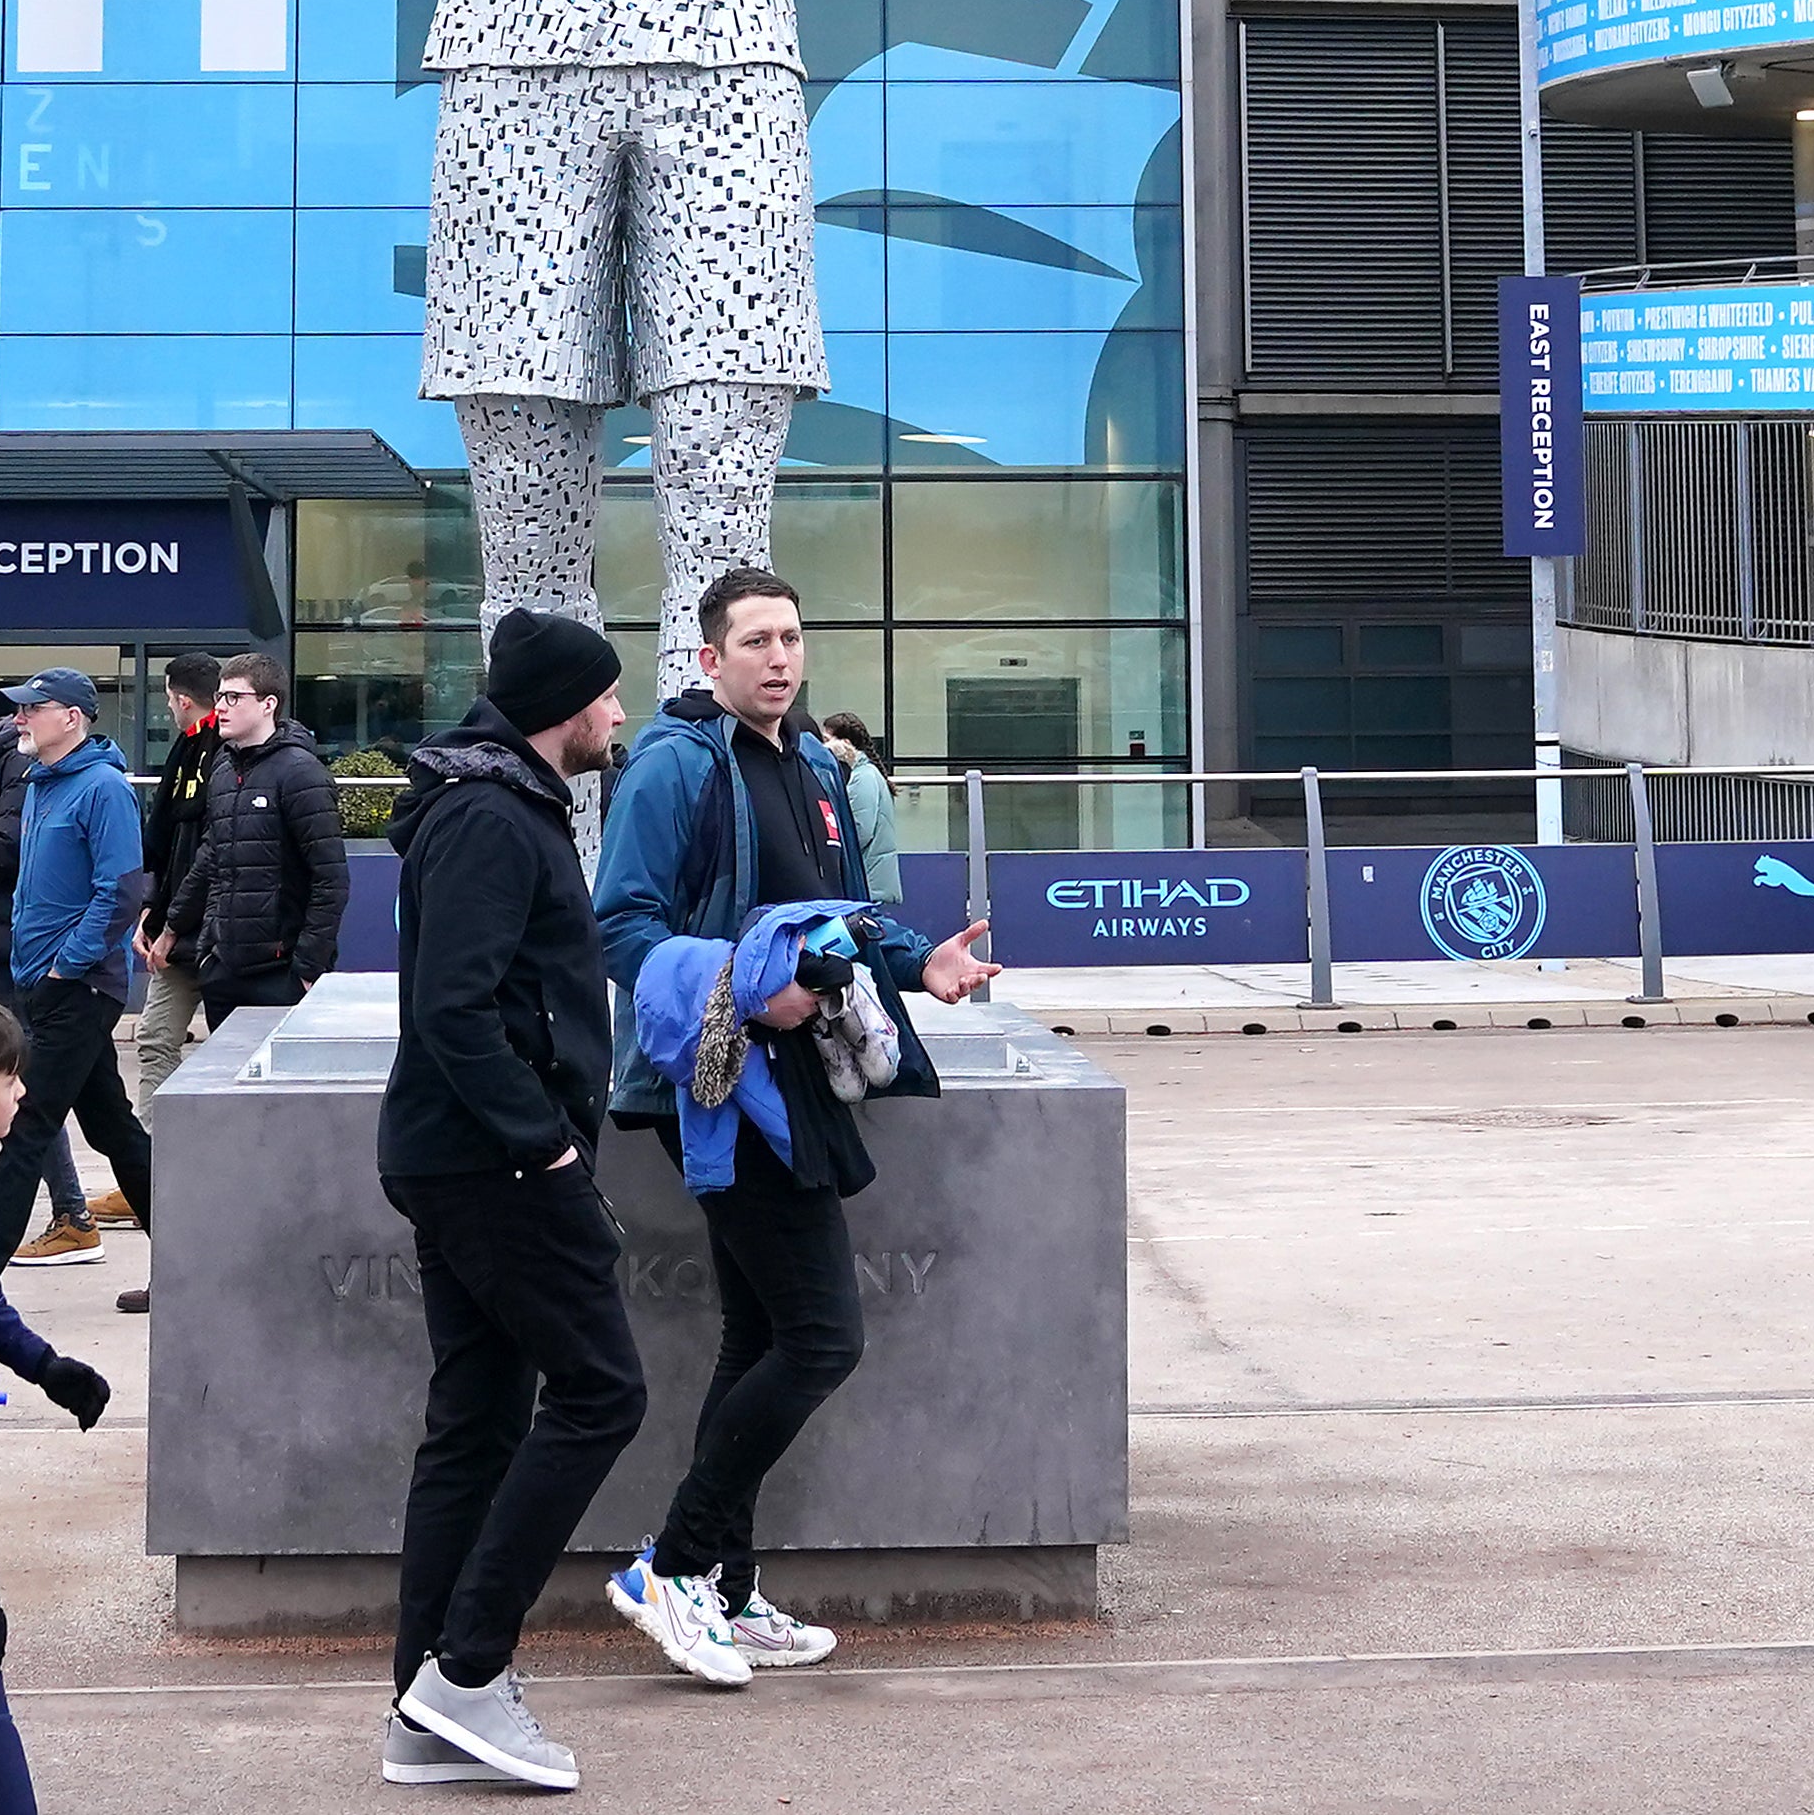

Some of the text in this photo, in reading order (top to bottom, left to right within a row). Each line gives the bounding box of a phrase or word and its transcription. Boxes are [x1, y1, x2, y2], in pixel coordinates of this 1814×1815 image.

[1529, 304, 1554, 529] EAST RECEPTION
[1431, 850, 1523, 900] MANCHESTER
[1047, 879, 1249, 908] ETIHAD
[1093, 917, 1206, 936] AIRWAYS
[1481, 939, 1514, 958] CITY
